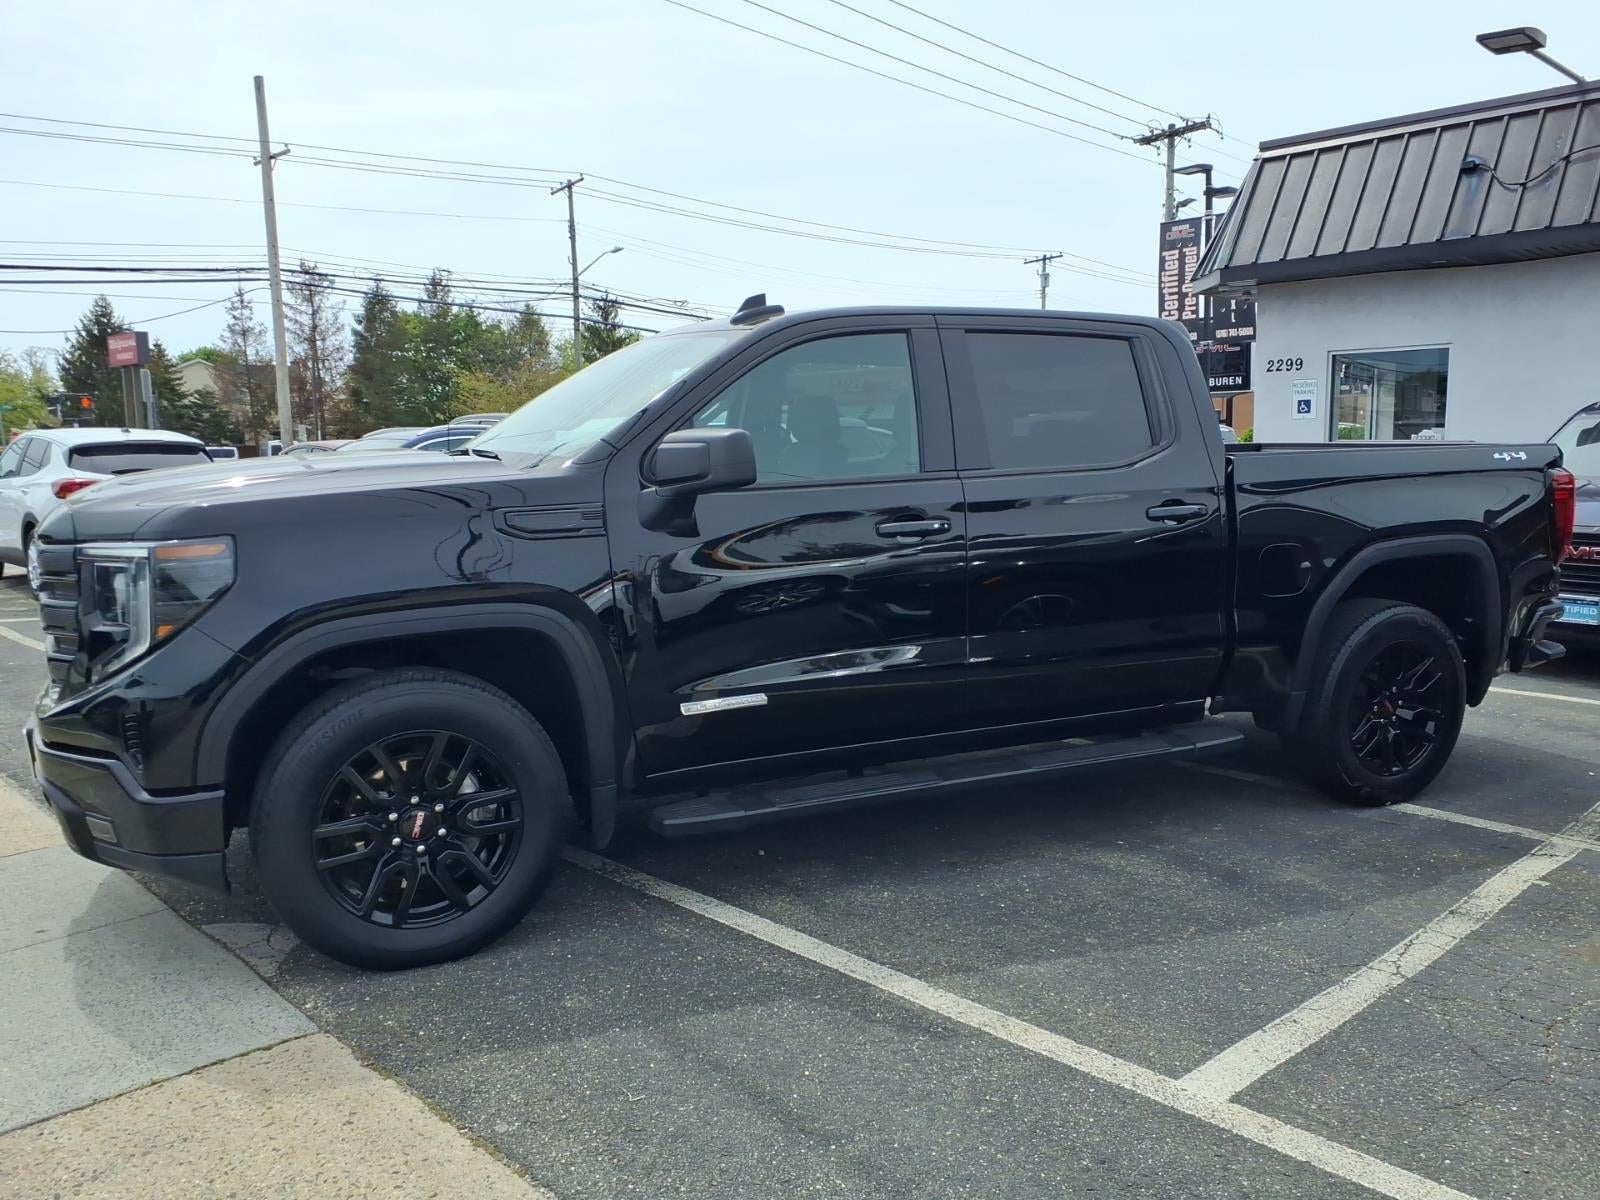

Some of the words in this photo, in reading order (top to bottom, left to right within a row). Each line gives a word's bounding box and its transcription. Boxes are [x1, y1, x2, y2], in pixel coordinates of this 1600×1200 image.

[1162, 249, 1179, 320] Certified
[1266, 358, 1304, 373] 2299
[1208, 376, 1242, 387] BUREN
[1563, 605, 1598, 616] TIFIED
